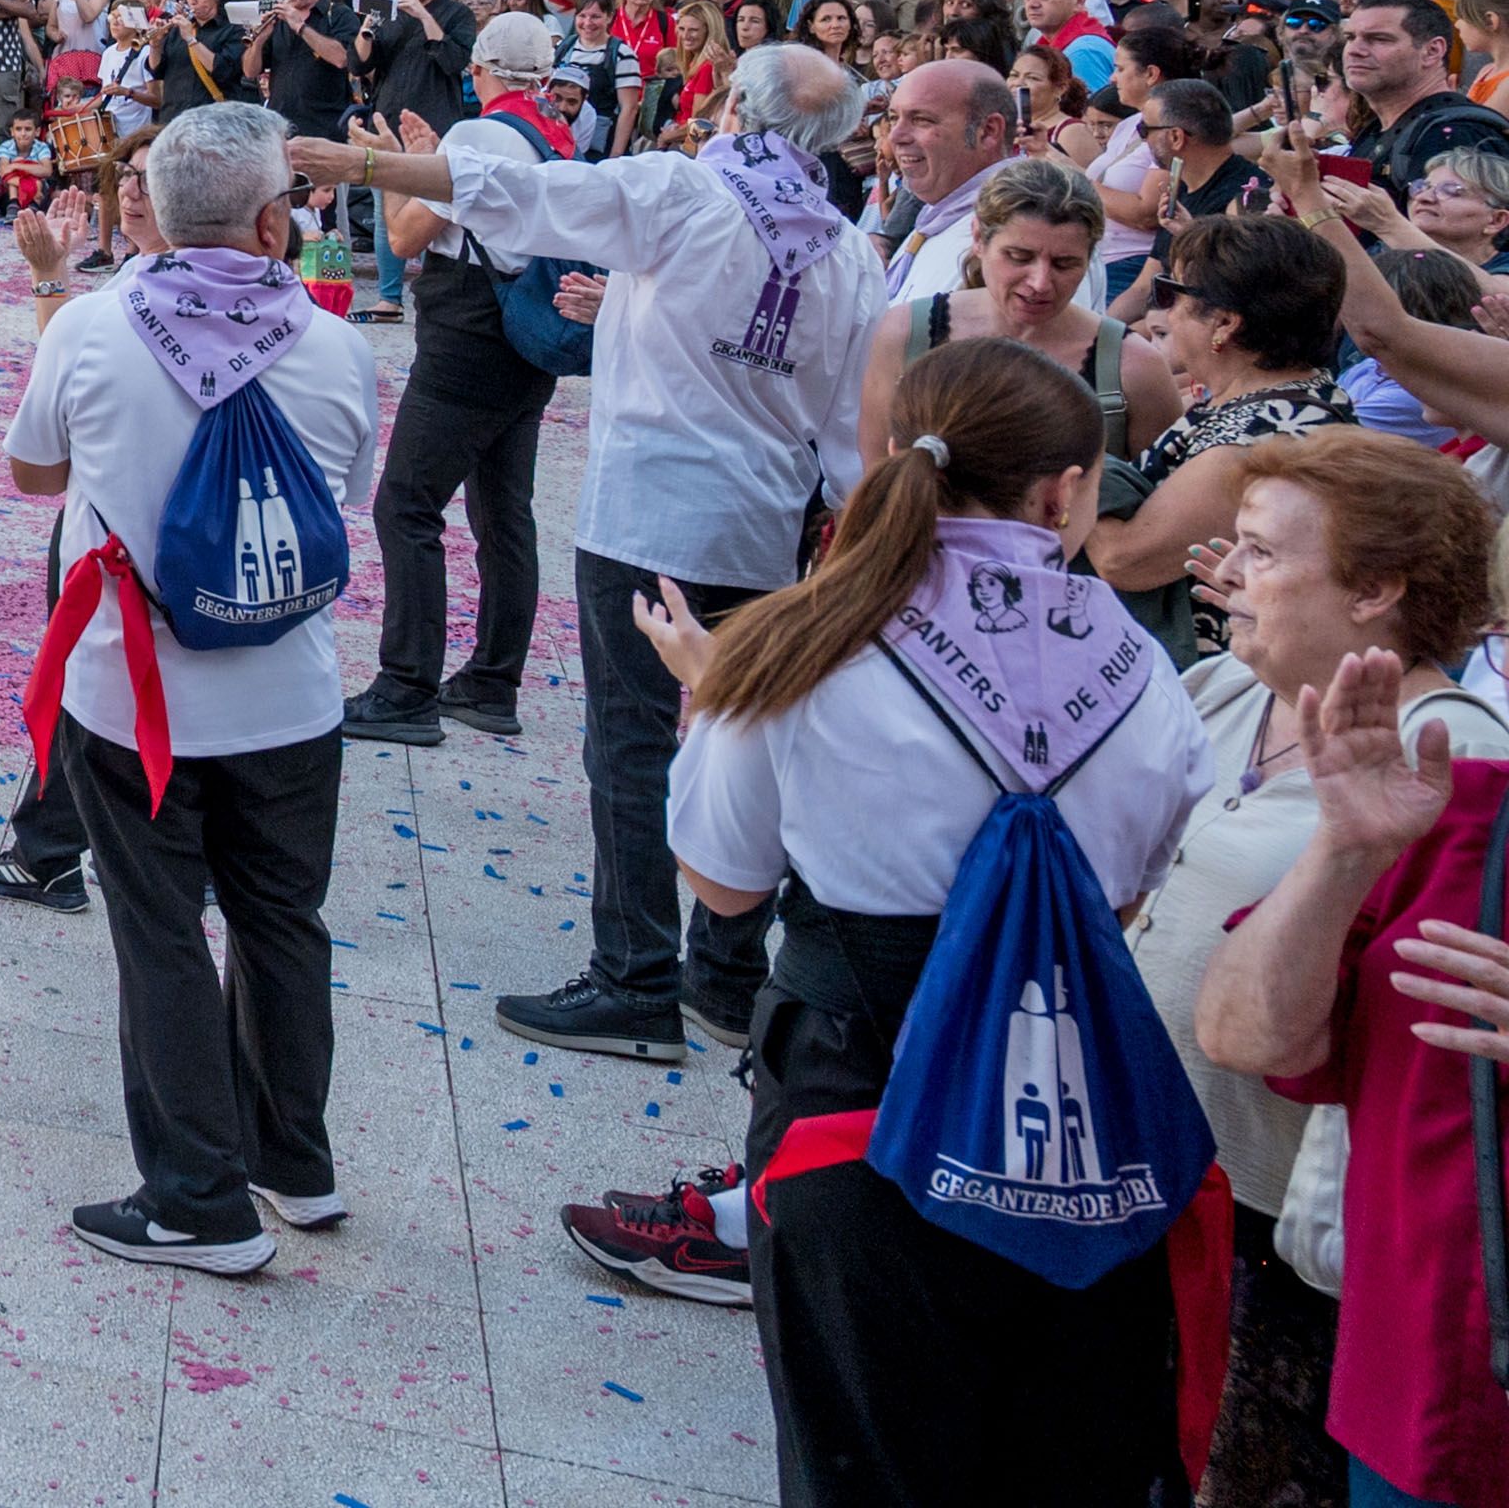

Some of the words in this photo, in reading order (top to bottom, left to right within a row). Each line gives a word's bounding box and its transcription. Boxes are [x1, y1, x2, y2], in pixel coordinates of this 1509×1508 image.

[805, 236, 822, 253] DE
[128, 290, 192, 367] GEGANTERS
[228, 352, 253, 373] DE
[254, 318, 294, 355] RUBÍ
[712, 341, 769, 369] GEGANTERS
[195, 595, 281, 621] GEGANTERS
[284, 597, 304, 613] DE
[899, 606, 1007, 713] GANTERS
[1063, 686, 1099, 723] DE
[1099, 625, 1142, 688] RUBÍ
[931, 1168, 1079, 1219] GEGANTERS
[1082, 1193, 1113, 1219] DE
